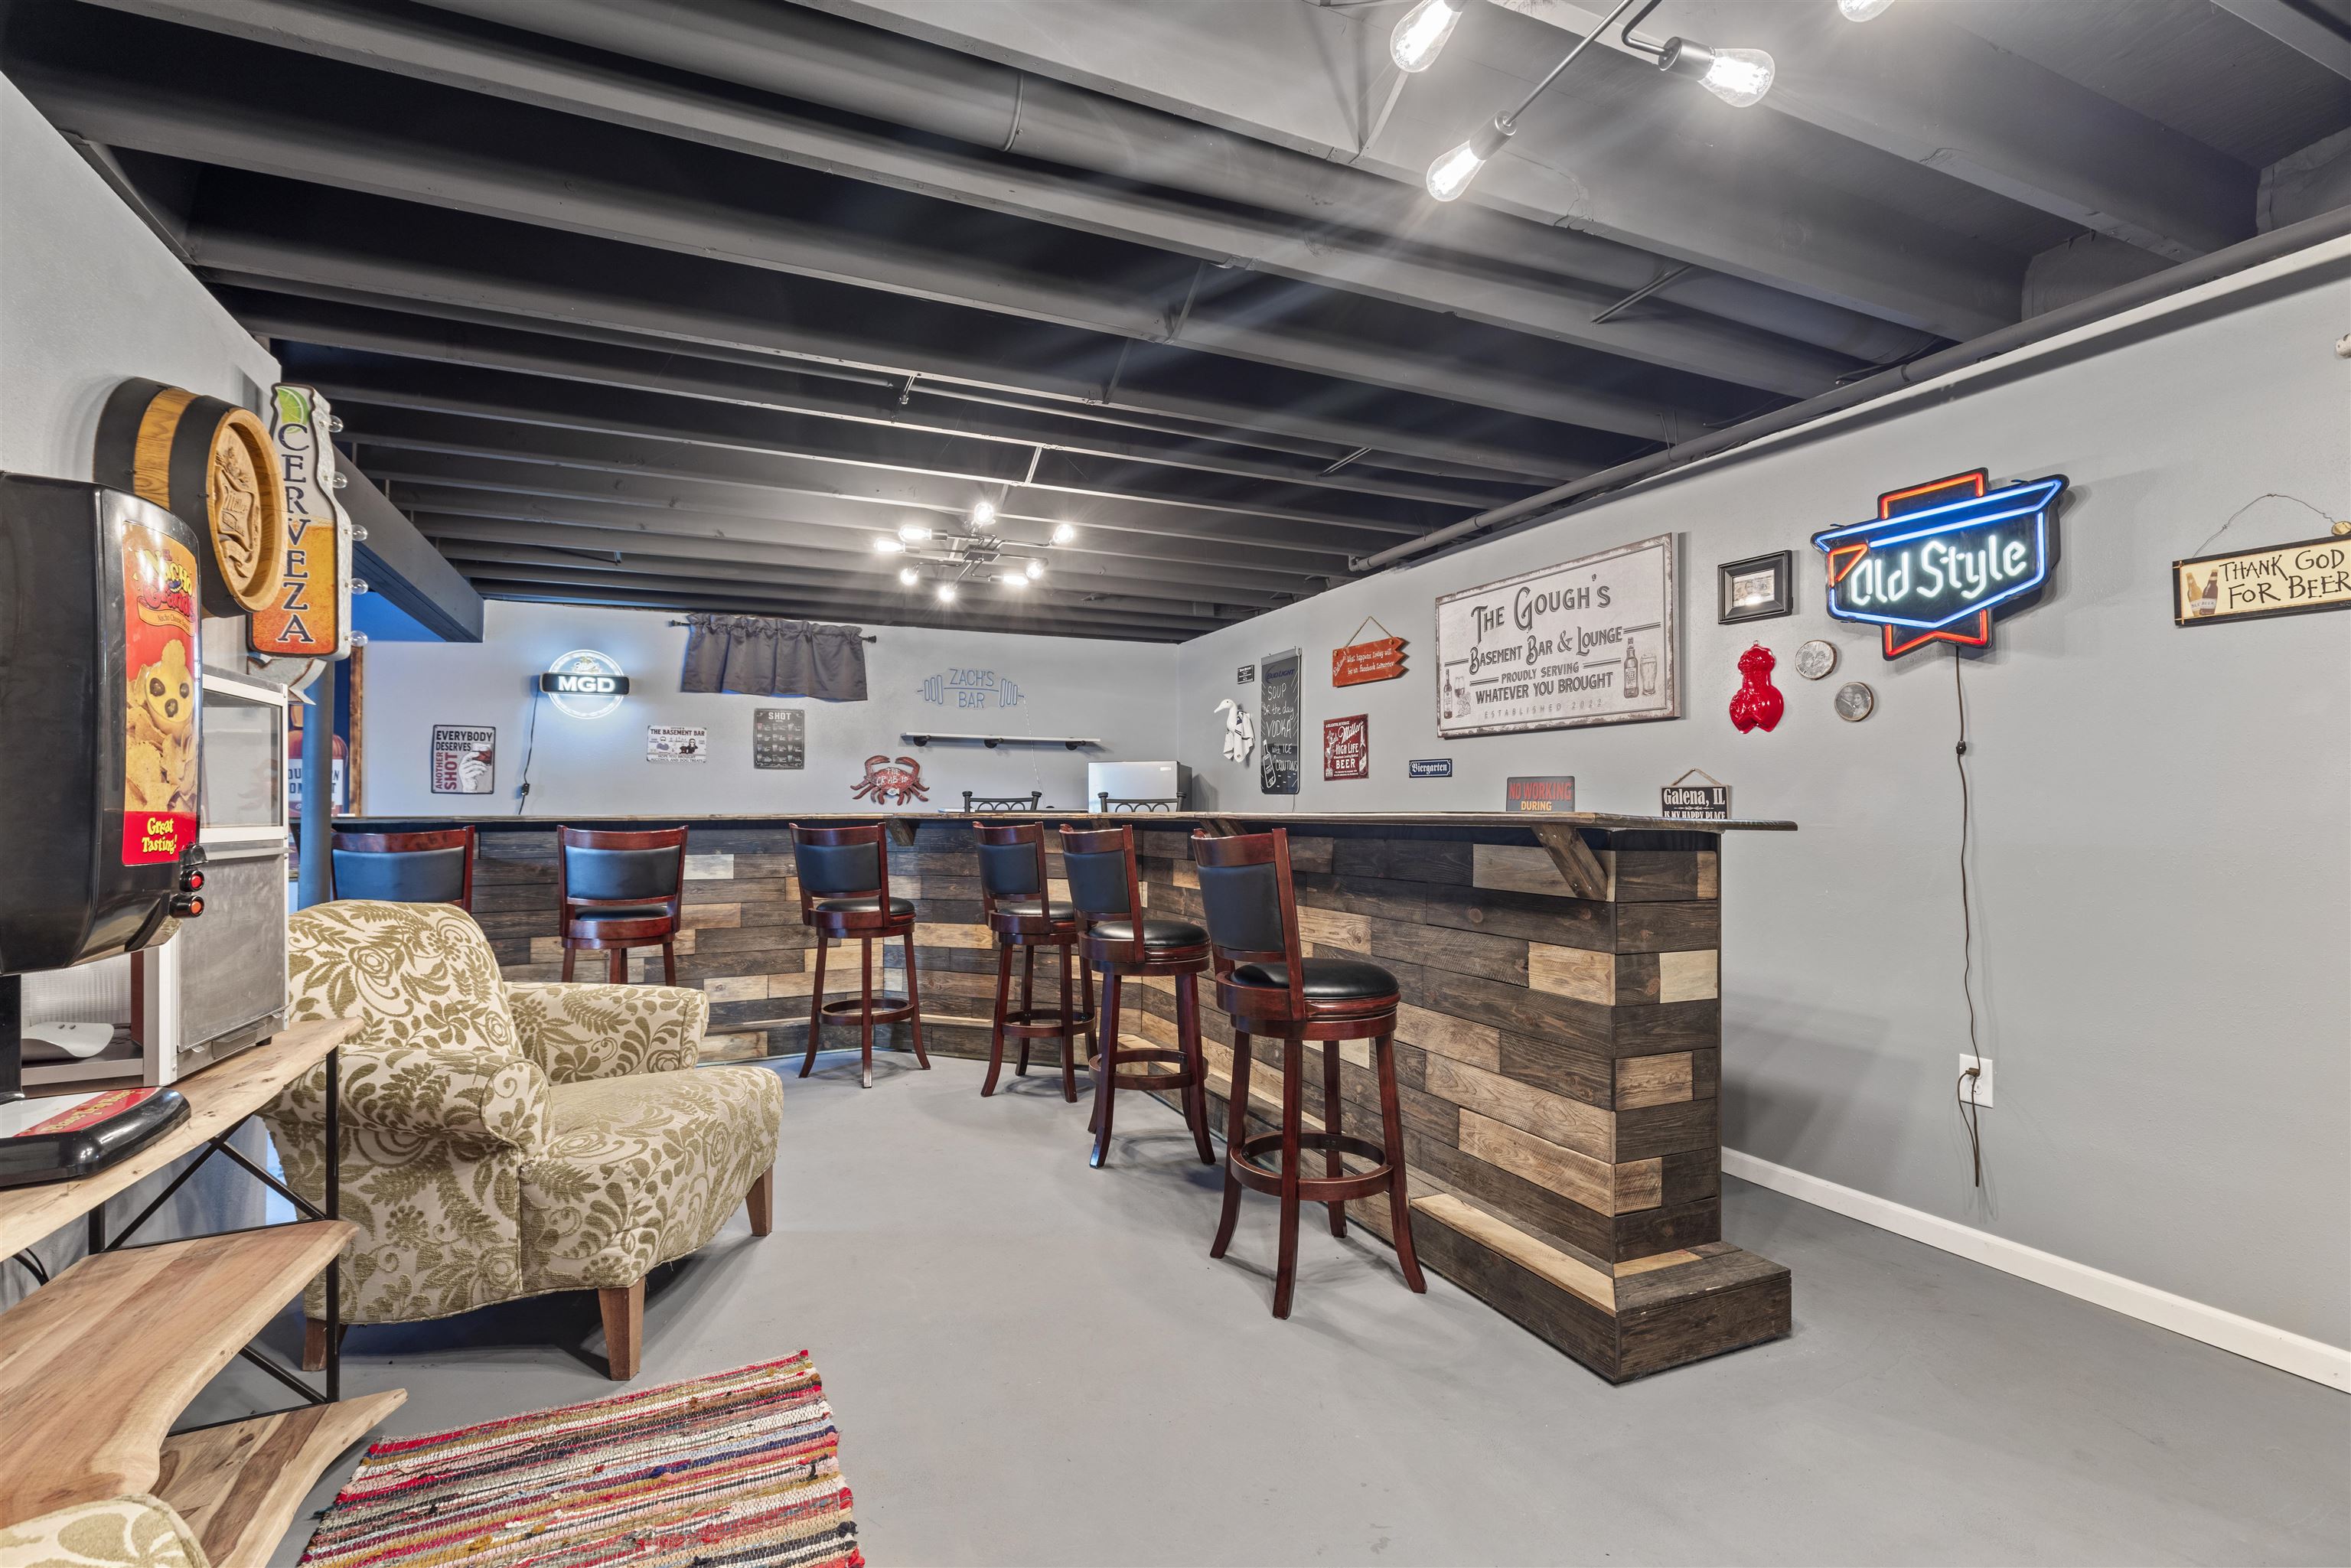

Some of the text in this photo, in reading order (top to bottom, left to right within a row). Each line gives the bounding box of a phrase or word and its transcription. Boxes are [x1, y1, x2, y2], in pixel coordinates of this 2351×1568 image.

[276, 423, 315, 642] CERVEZA
[1850, 533, 2028, 606] Old Style
[2219, 549, 2345, 582] THANK GOD
[2229, 571, 2351, 609] FOR BEER
[1471, 573, 1611, 645] THE GOUGH'S
[1469, 626, 1623, 675] BASEMENT BAR & LOUNGE
[949, 669, 995, 687] ZACH'S
[1501, 661, 1580, 684] PROUDLY SERVING
[558, 676, 615, 693] MGD
[1267, 683, 1286, 701] SOUP
[1475, 672, 1614, 704] WHATEVER YOU BROUGHT
[958, 691, 985, 709] BAR
[768, 712, 791, 720] SHOT
[1272, 703, 1281, 715] the
[1282, 700, 1294, 720] day
[1485, 702, 1562, 719] ESTABLISHED
[436, 730, 493, 742] EVERYBODY
[1338, 721, 1364, 745] Miller
[435, 742, 471, 752] DESERVES
[1283, 743, 1293, 754] ICE
[1335, 741, 1359, 755] HIGH LIFE
[435, 751, 444, 790] ANOTHER
[445, 751, 458, 790] SHOT
[1335, 758, 1355, 770] BEER
[1411, 762, 1448, 774] Biergarten
[1509, 782, 1572, 800] NO WORKING
[1663, 787, 1726, 807] Galena, IL
[1521, 800, 1552, 811] DURING
[1683, 811, 1704, 820] HAPPY
[147, 817, 174, 836] Great
[142, 834, 178, 855] Tasting!
